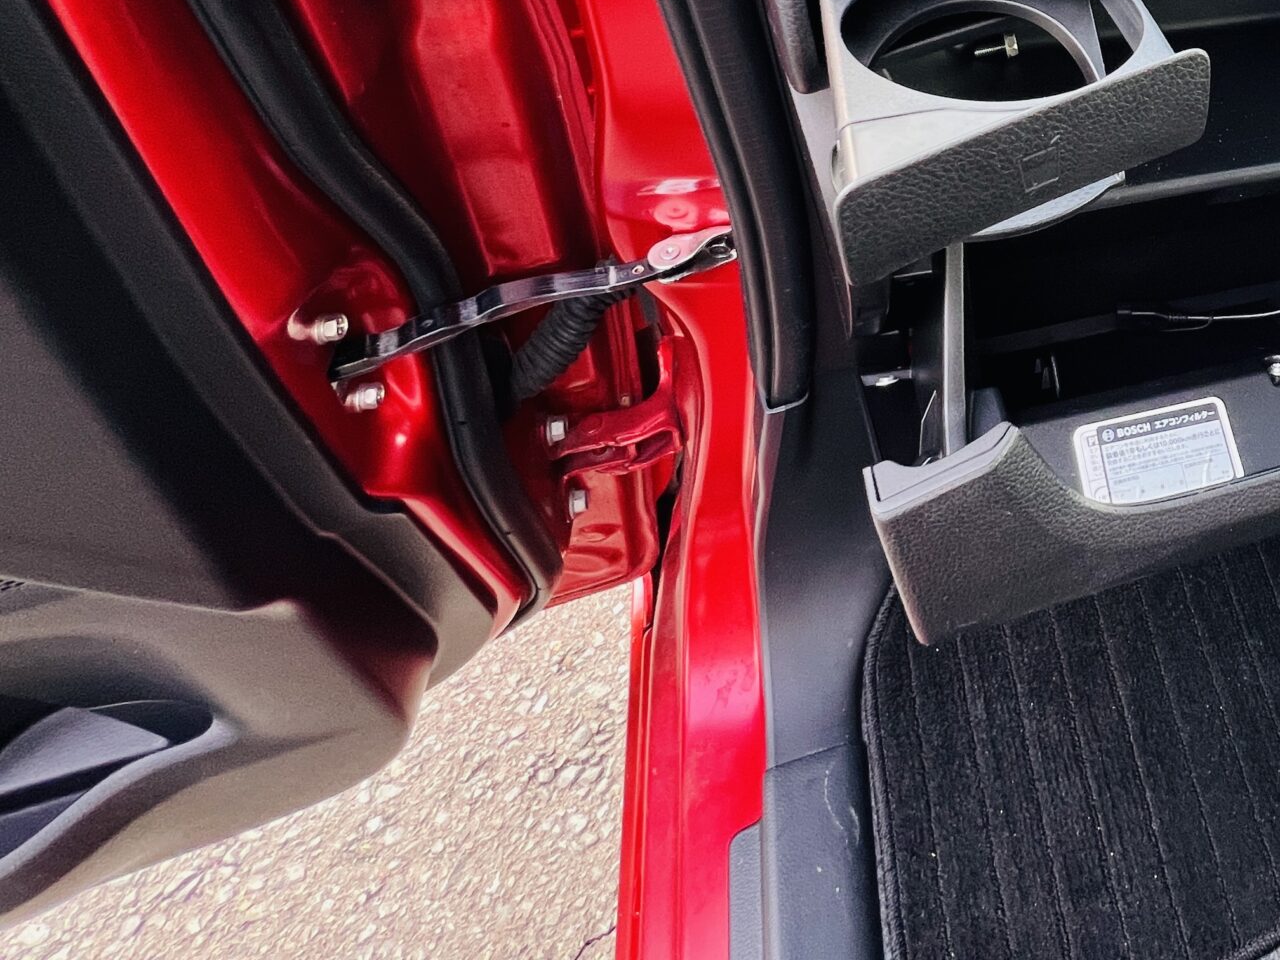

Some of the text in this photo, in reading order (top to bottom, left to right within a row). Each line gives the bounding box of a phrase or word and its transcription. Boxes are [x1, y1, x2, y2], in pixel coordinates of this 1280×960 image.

[1117, 410, 1216, 438] BOSCH エアコンフィルター
